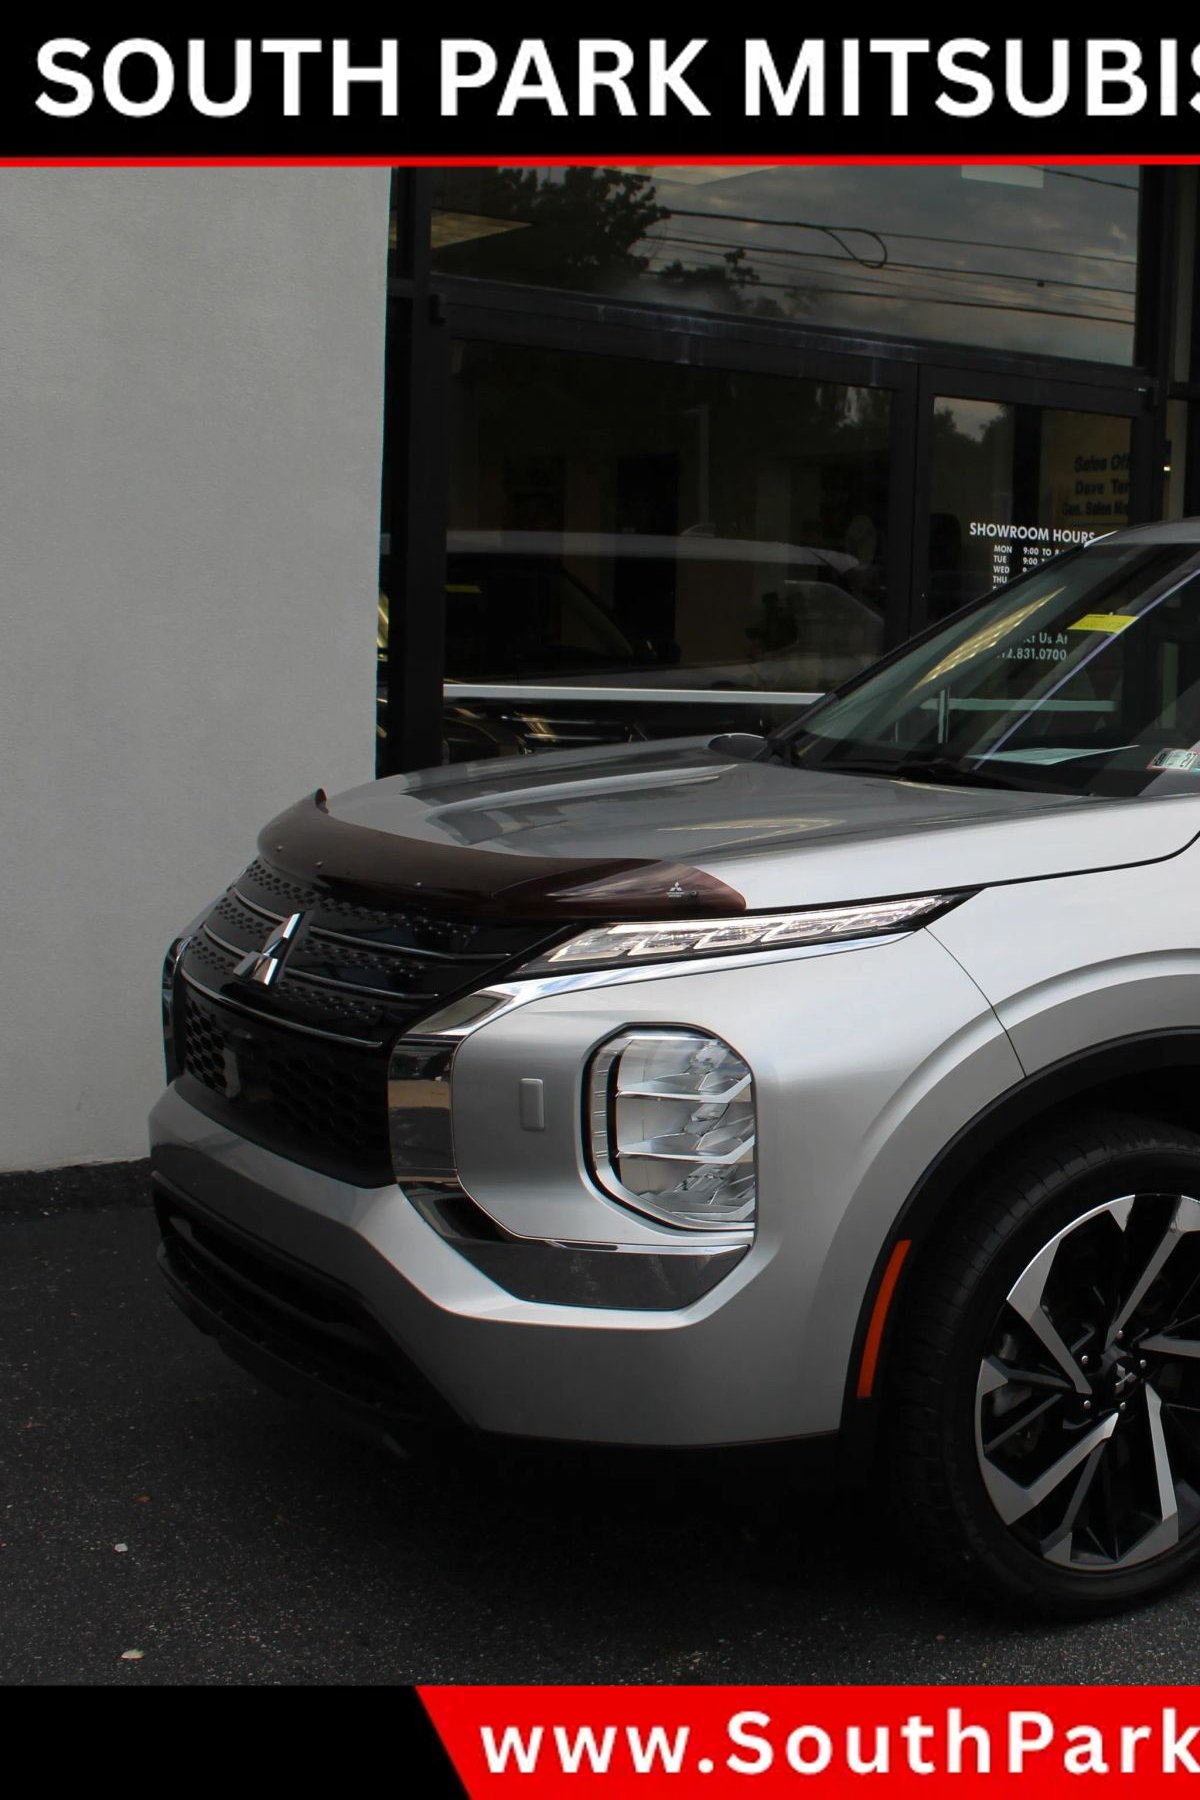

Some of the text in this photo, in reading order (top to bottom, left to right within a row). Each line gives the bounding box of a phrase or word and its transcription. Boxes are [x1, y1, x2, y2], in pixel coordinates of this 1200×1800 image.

[969, 522, 1096, 544] SHOWROOM HOURS
[993, 545, 1012, 553] MON
[1022, 546, 1039, 556] 9:00
[1042, 548, 1051, 556] TO
[993, 555, 1007, 563] TUE
[1022, 557, 1038, 566] 9:00
[992, 566, 1010, 574] WED
[992, 576, 1008, 584] THU
[997, 648, 1067, 660] 2.831.0700
